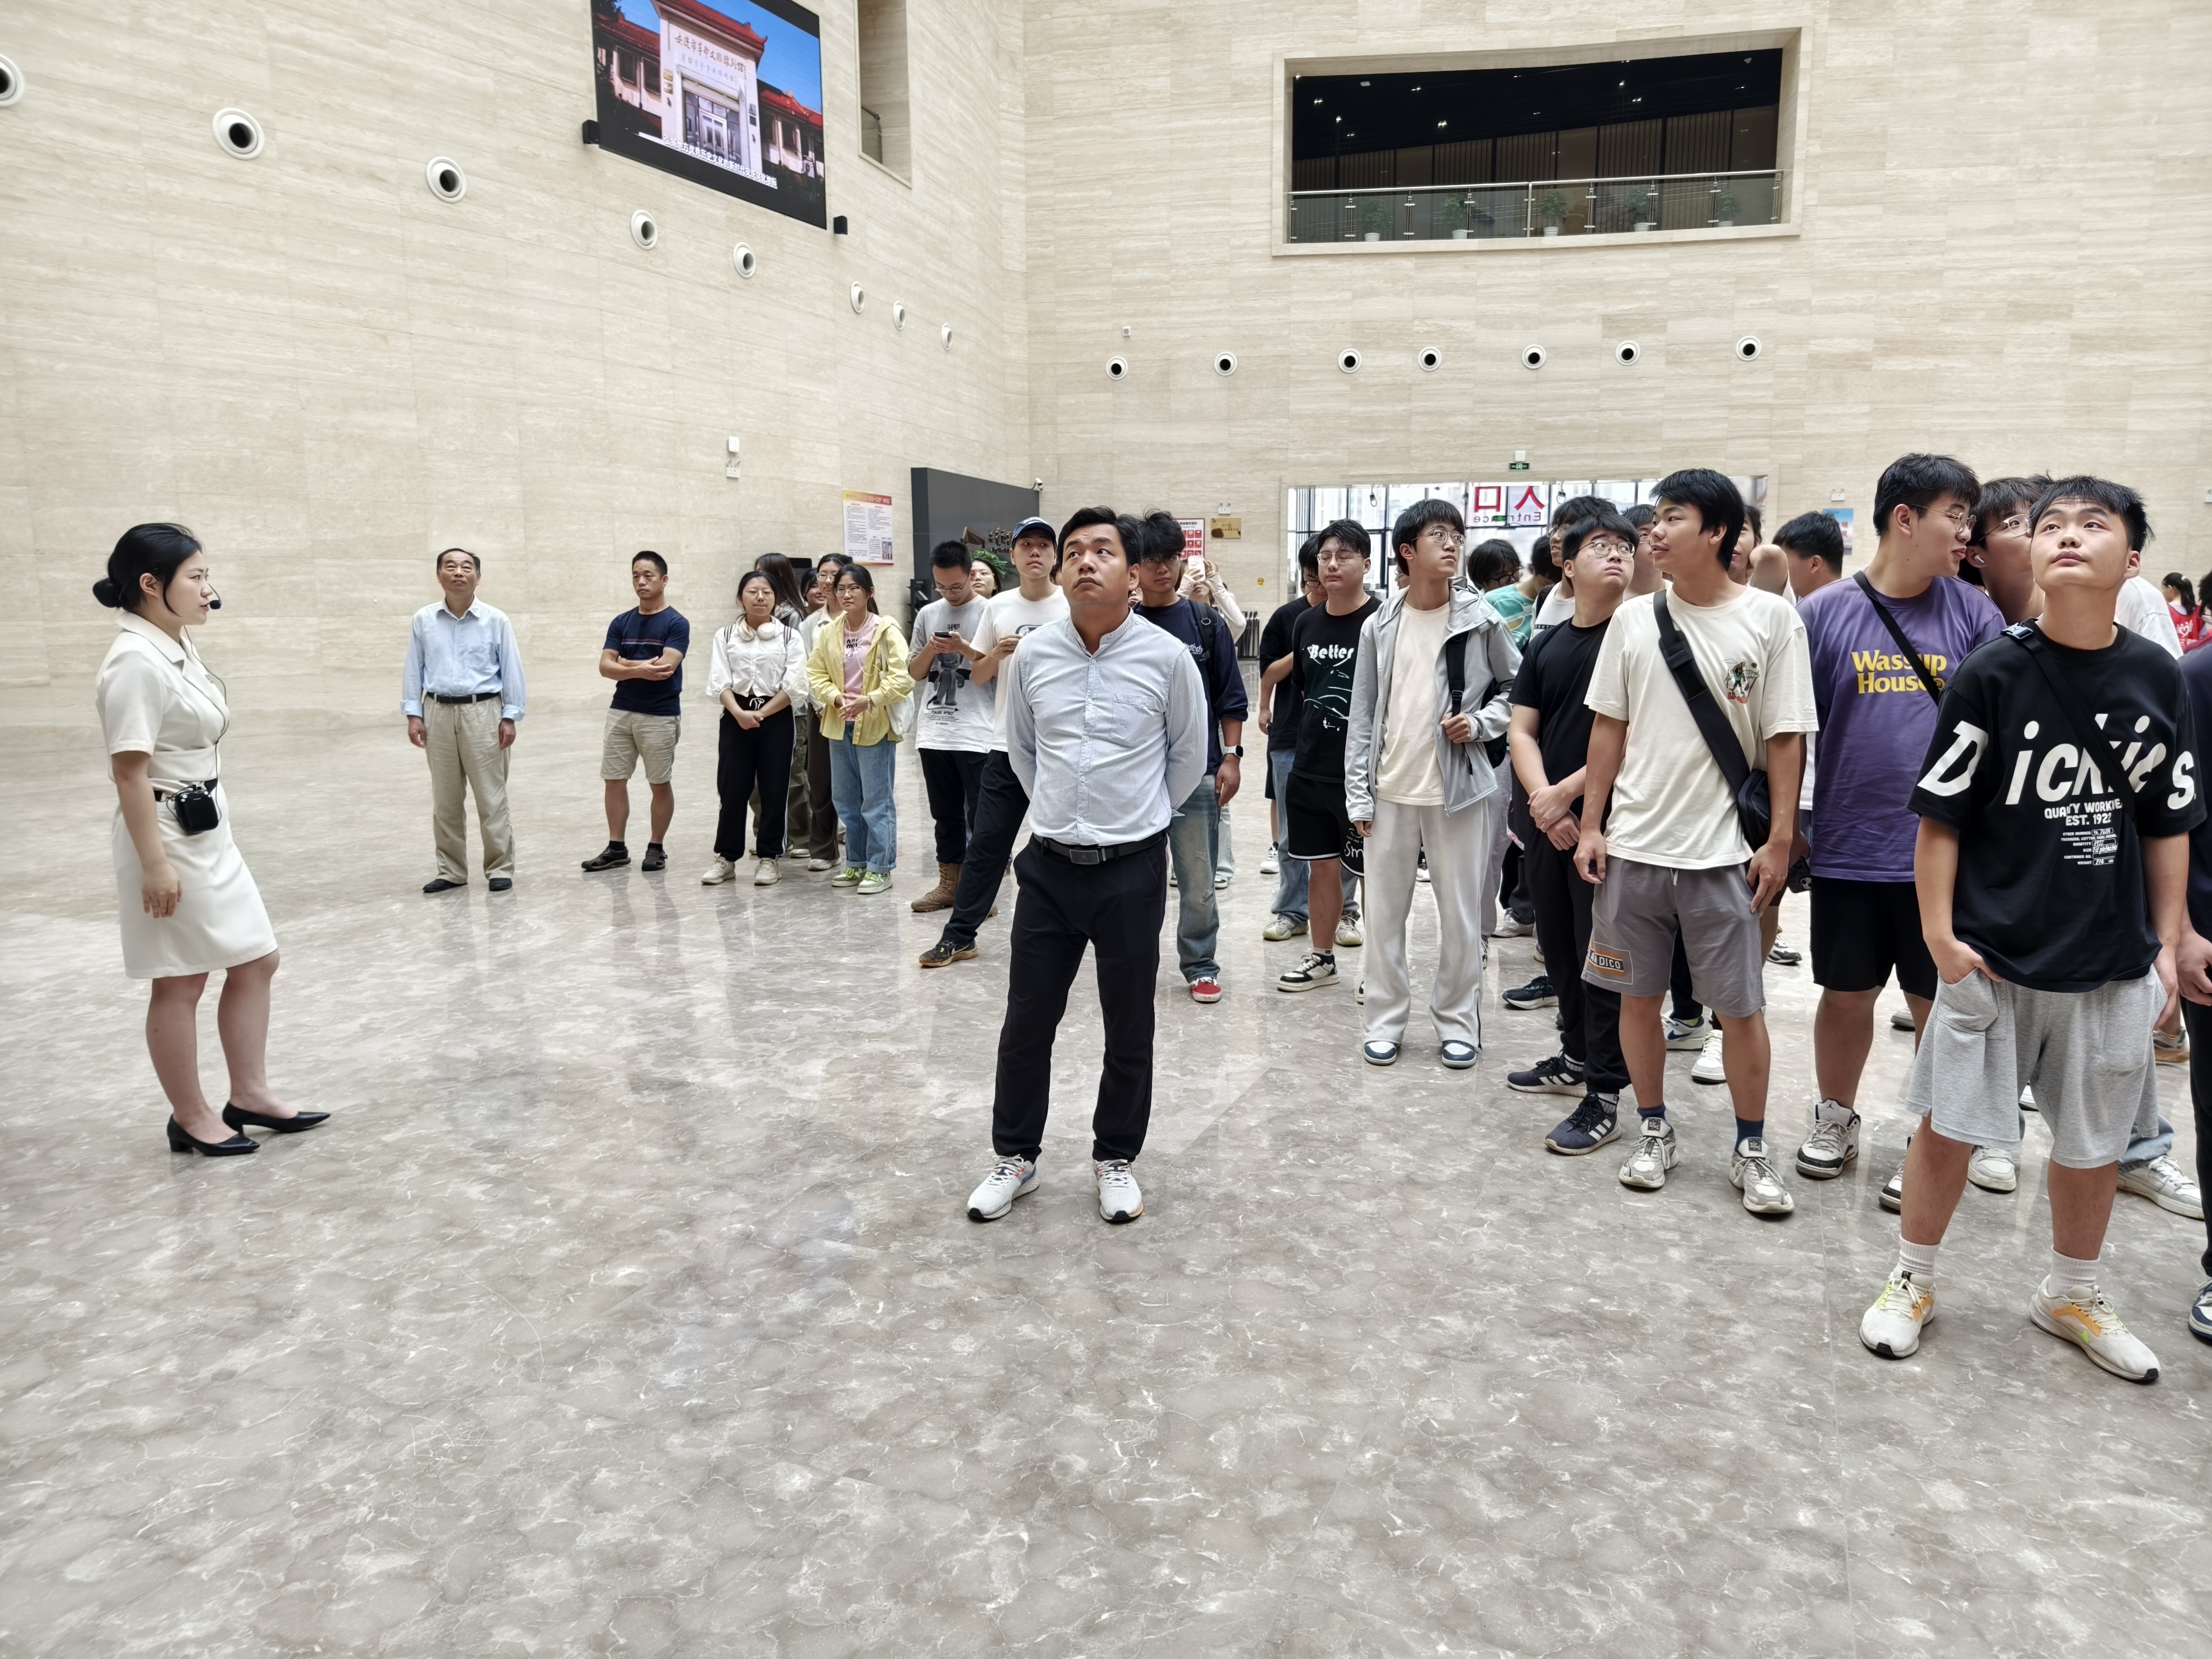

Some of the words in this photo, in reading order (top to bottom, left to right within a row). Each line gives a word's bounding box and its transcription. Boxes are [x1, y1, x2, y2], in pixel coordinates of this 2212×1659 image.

[1307, 644, 1354, 659] Better
[2066, 814, 2089, 826] EST.
[2093, 813, 2112, 825] 1922
